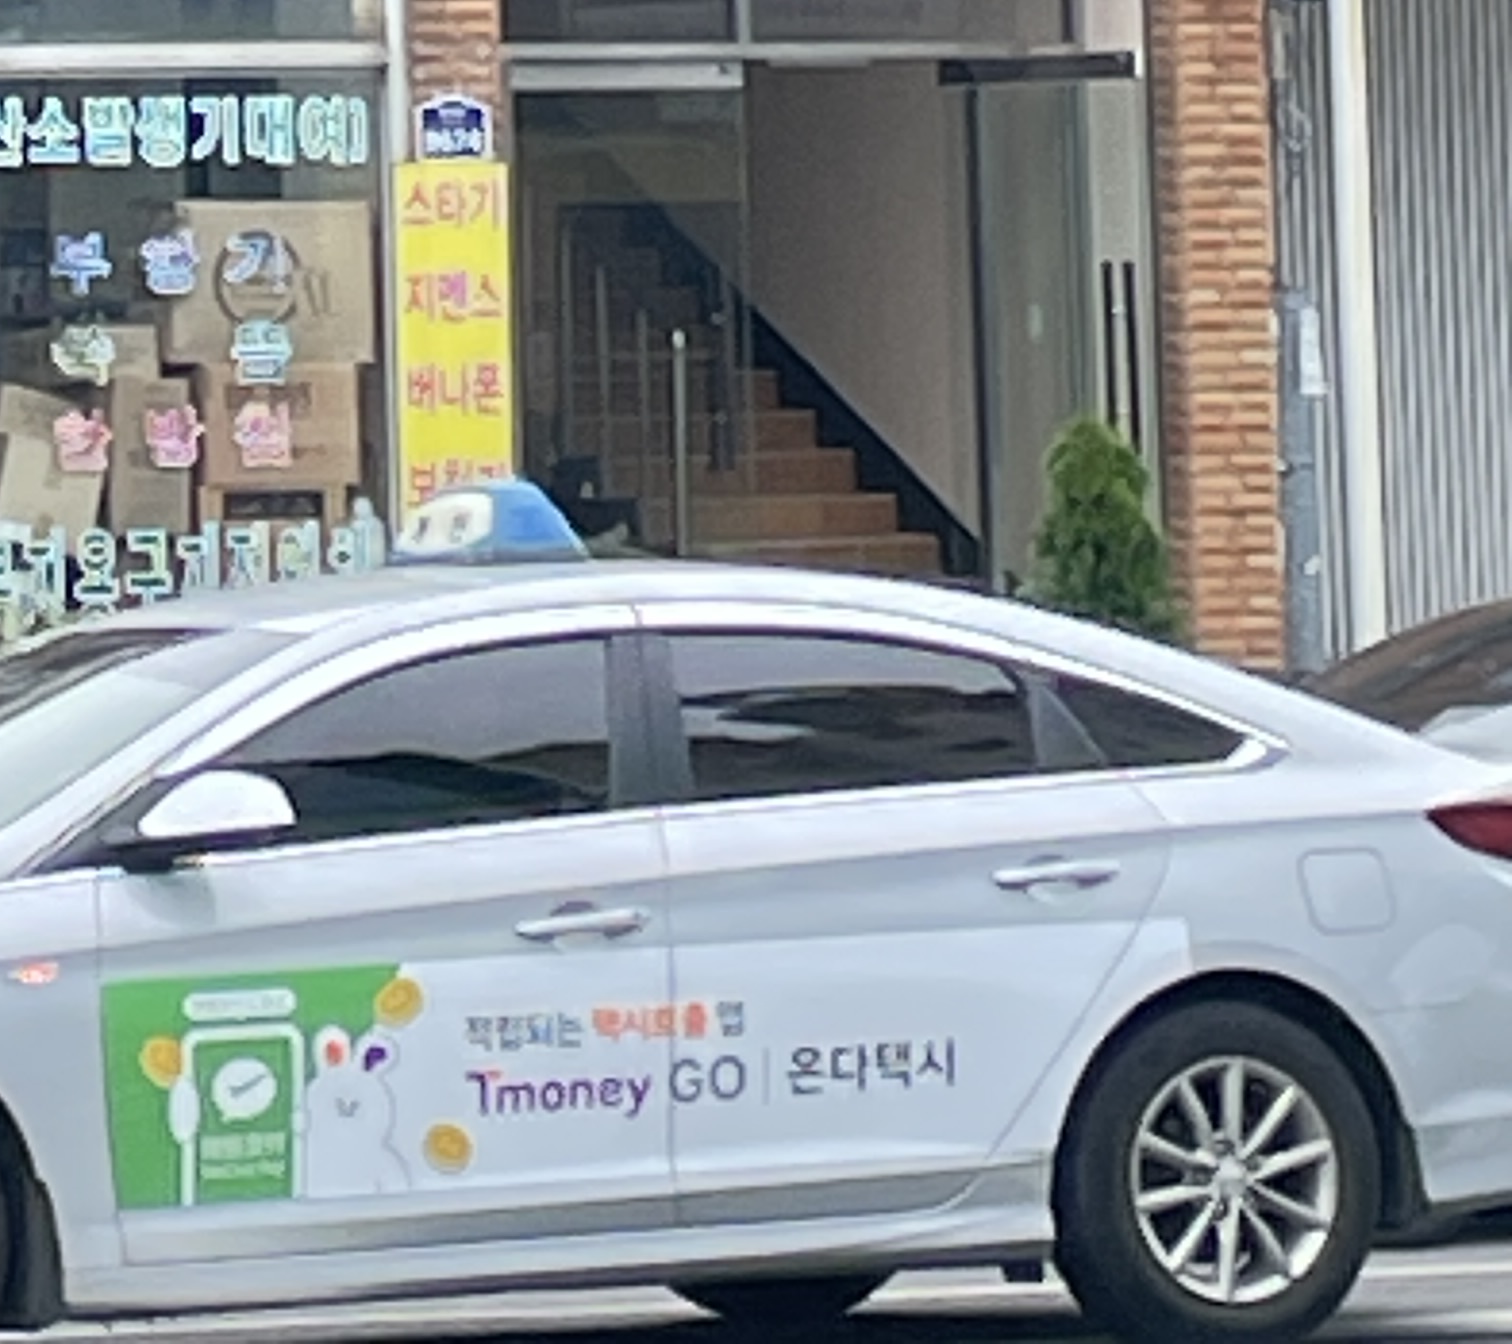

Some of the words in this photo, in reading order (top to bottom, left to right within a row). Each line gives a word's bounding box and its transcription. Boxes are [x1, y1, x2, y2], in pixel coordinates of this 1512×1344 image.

[465, 1069, 651, 1119] Tmoney
[669, 1055, 746, 1103] GO
[786, 1038, 959, 1096] 온다택시
